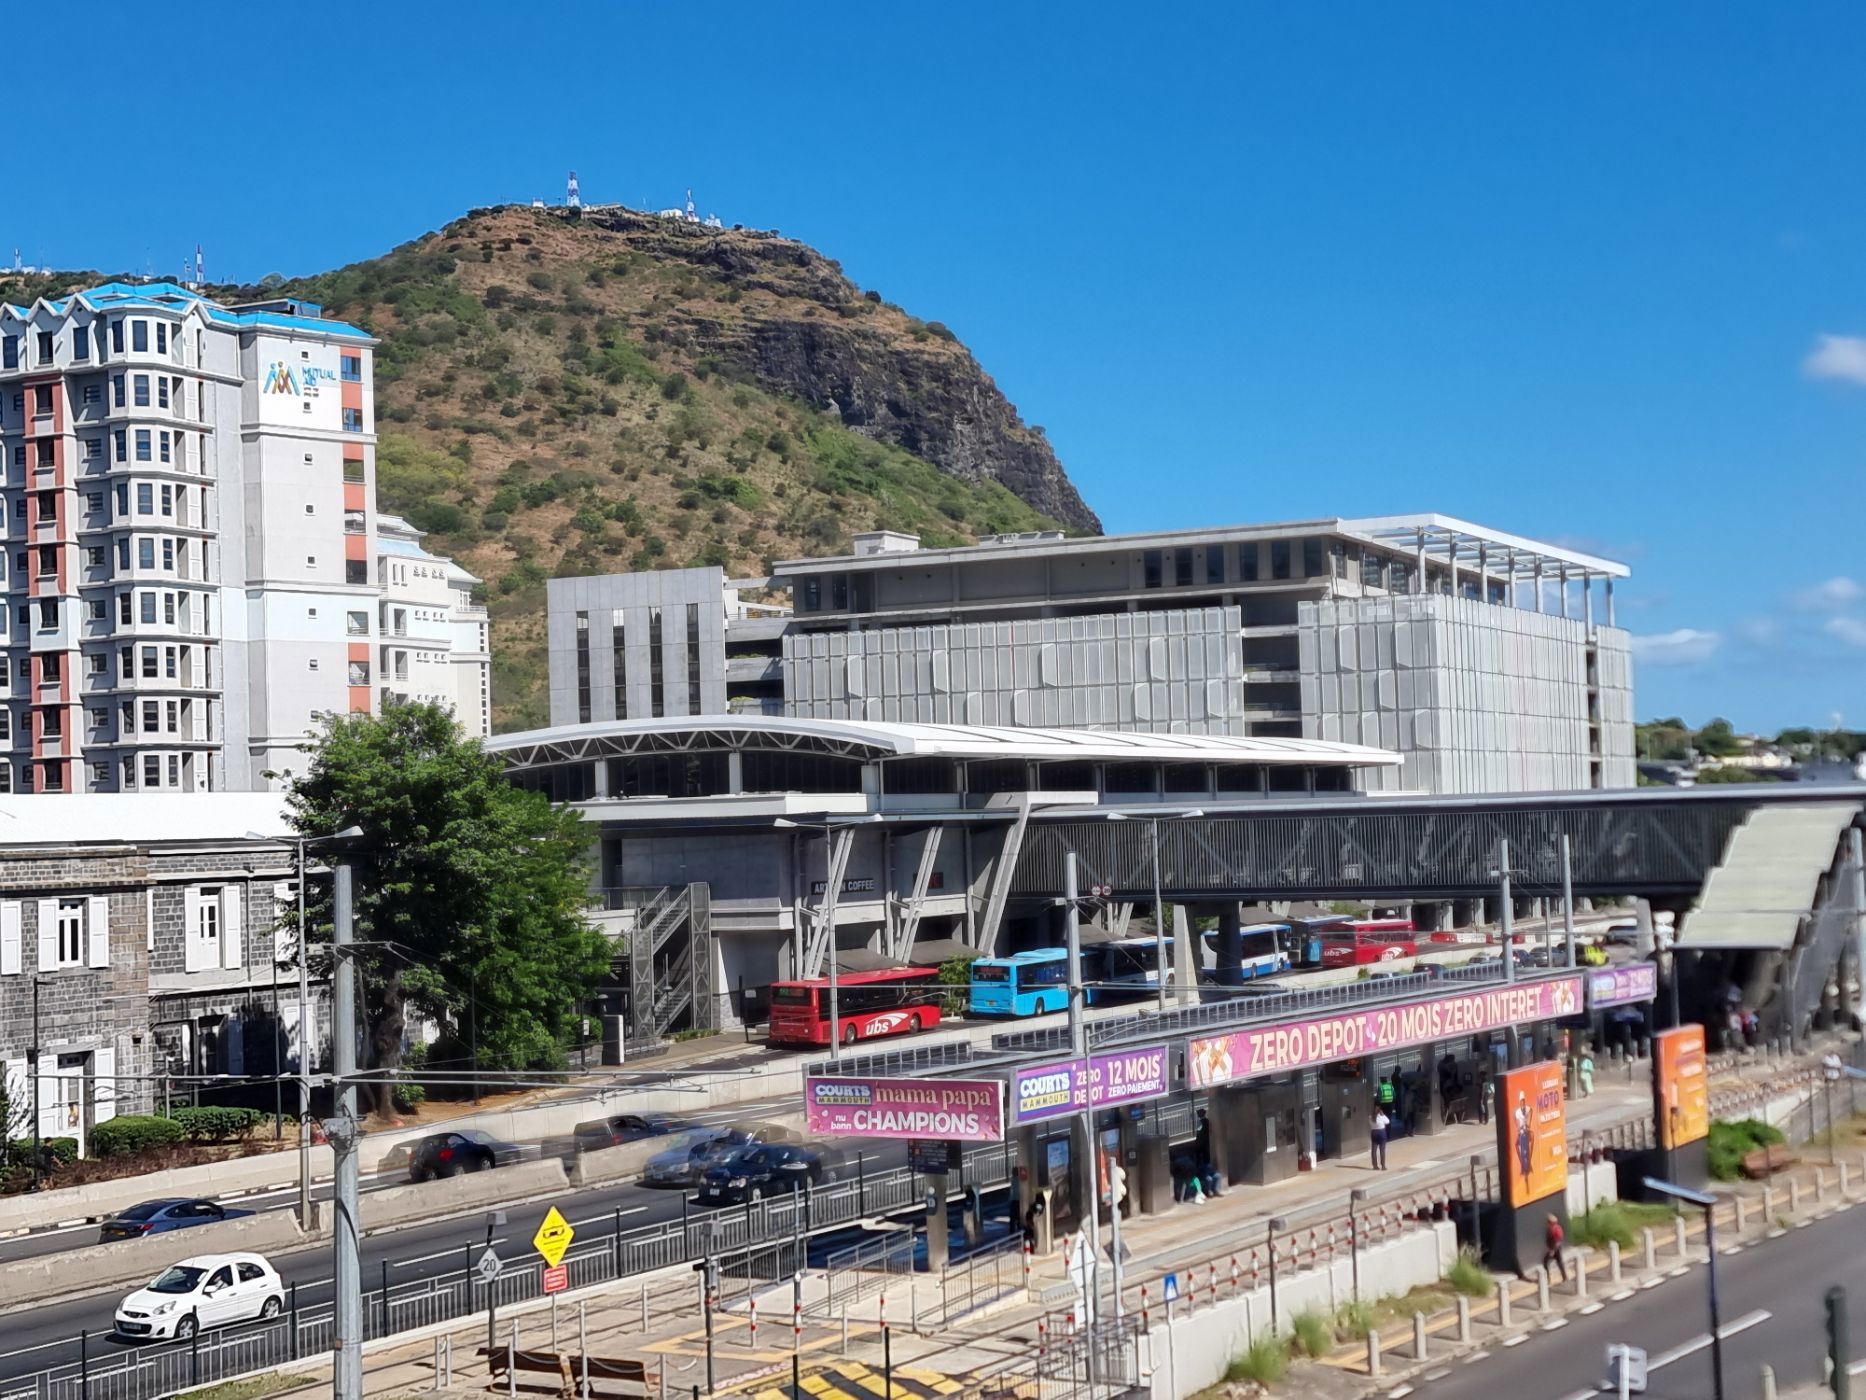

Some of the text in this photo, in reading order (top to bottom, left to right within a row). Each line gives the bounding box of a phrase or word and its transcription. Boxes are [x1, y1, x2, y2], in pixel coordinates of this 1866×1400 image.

[302, 366, 336, 380] MUTUAL
[848, 880, 874, 891] COFFEE
[1324, 948, 1341, 957] ubs
[866, 1020, 889, 1035] ubs
[1250, 987, 1542, 1072] ZERO DEPOT 20 MOIS ZERO INTERET
[1108, 1055, 1160, 1086] 12 MOIS
[816, 1084, 870, 1097] COURTS
[1020, 1072, 1070, 1098] COURTS
[1108, 1080, 1160, 1098] ZERO PAIEMENT
[818, 1097, 870, 1105] MAMMOUTH
[875, 1087, 992, 1111] mama papa
[1022, 1093, 1068, 1110] MAMMOUTH
[1074, 1085, 1103, 1105] DEOT
[1536, 1090, 1559, 1110] MOTO
[831, 1121, 852, 1130] bann
[836, 1114, 847, 1122] nu
[853, 1110, 979, 1134] CHAMPIONS
[483, 1258, 497, 1272] 20
